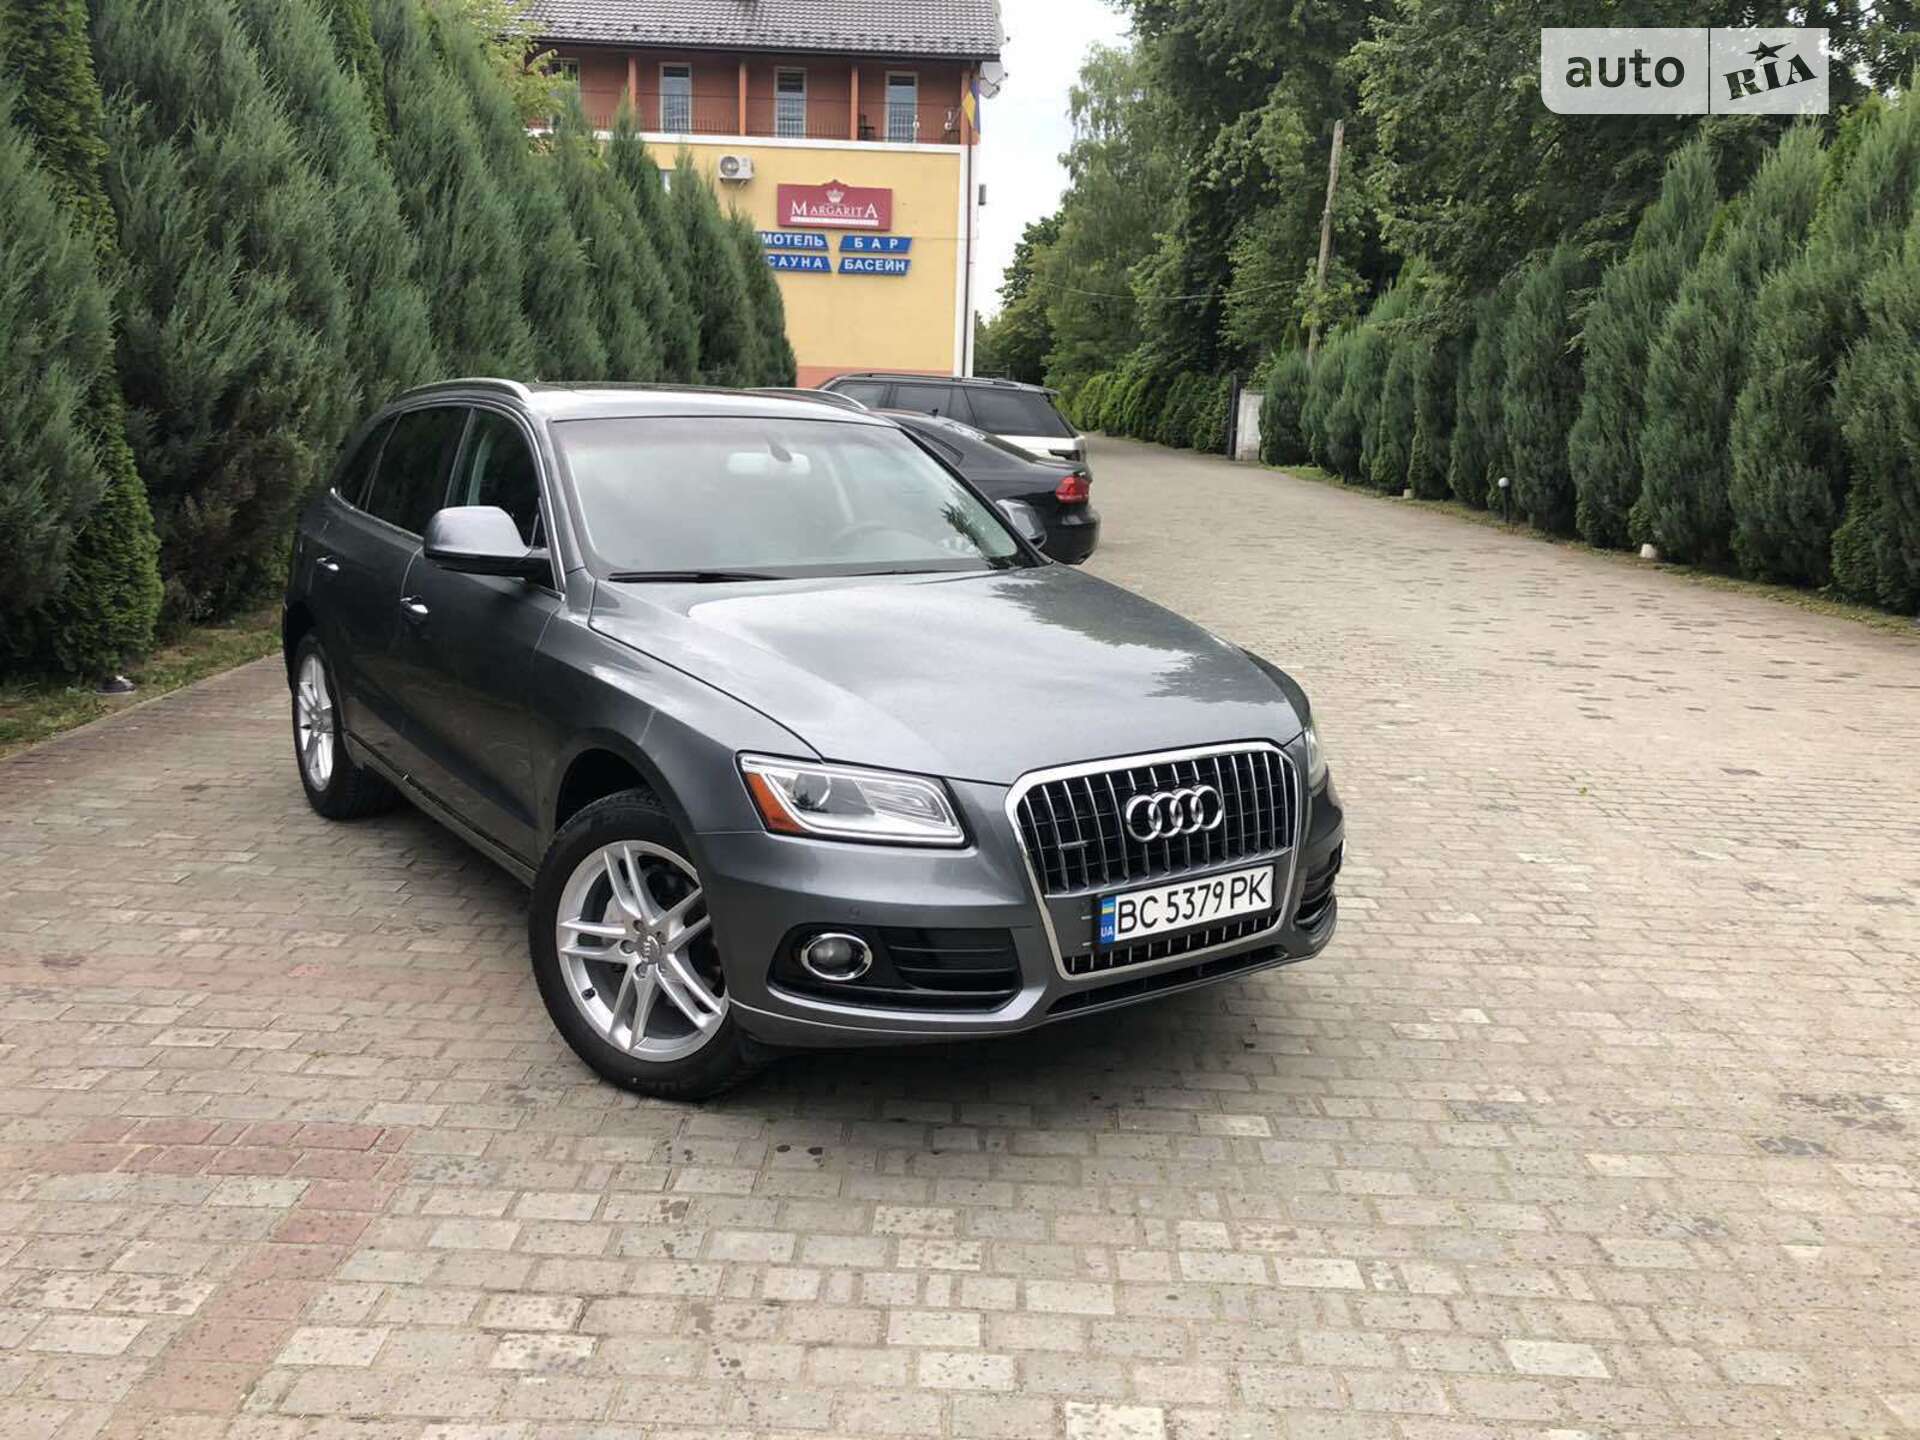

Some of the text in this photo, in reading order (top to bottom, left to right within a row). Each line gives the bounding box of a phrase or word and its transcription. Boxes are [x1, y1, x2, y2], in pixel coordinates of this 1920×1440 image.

[762, 233, 825, 247] МОТЕЛЬ
[854, 237, 898, 249] БАР
[767, 255, 823, 268] САУНА
[844, 258, 905, 271] БАСЕЙН
[1118, 871, 1268, 934] BC 5379 PK
[1101, 926, 1114, 938] UA
